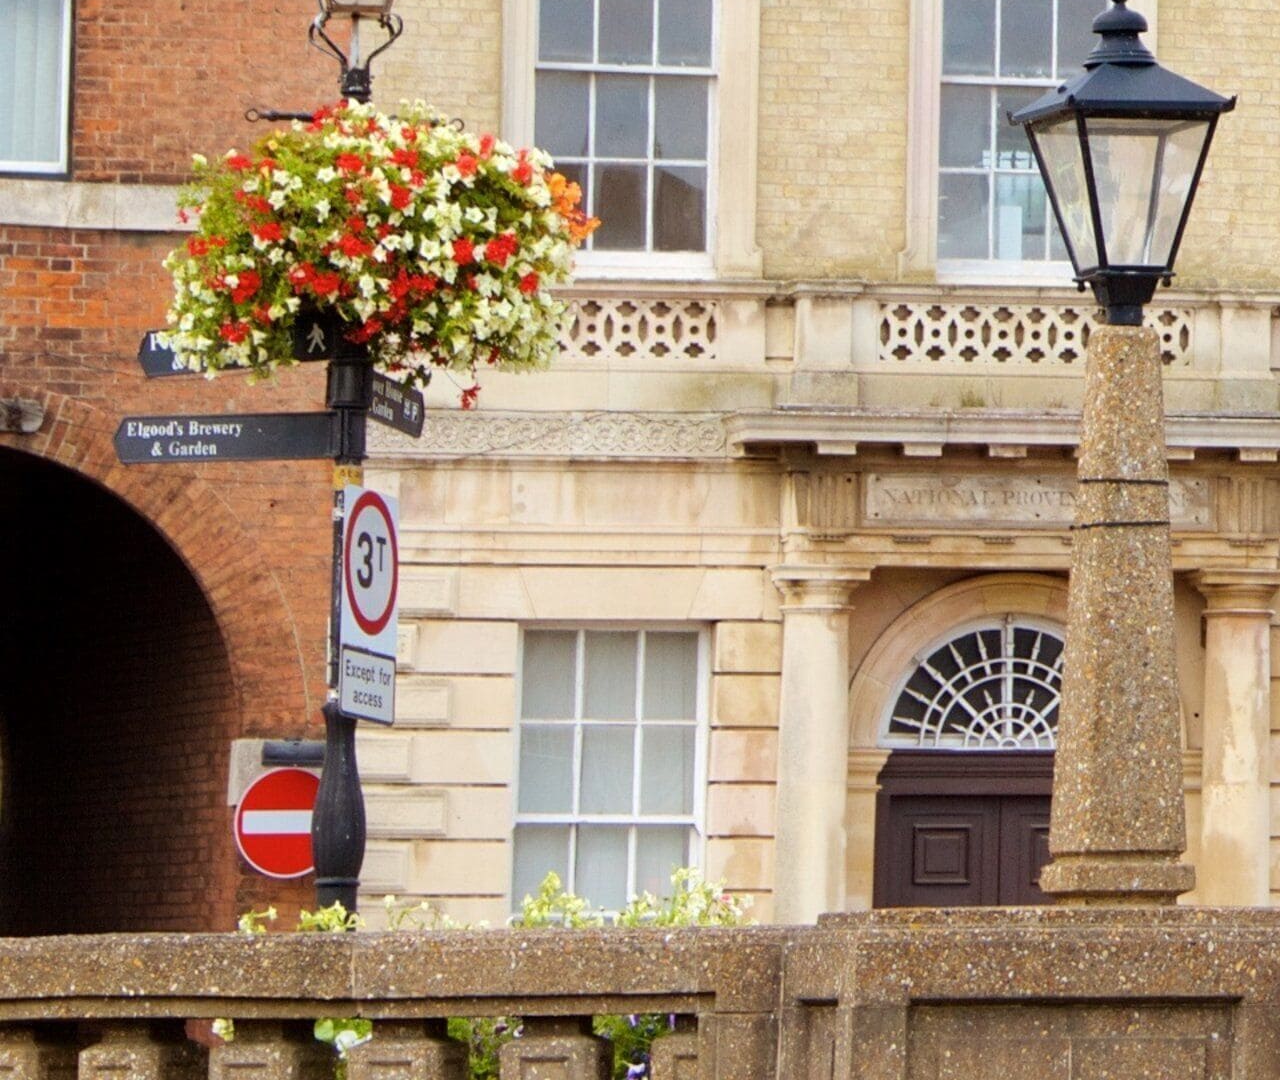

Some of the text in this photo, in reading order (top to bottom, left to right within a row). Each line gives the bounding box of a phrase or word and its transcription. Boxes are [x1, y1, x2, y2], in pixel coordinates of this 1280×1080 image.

[127, 420, 243, 440] Elgood's Brewery
[151, 440, 217, 457] & Garden
[884, 488, 995, 506] NATIONAL
[345, 658, 392, 686] Except for
[353, 688, 384, 709] access
